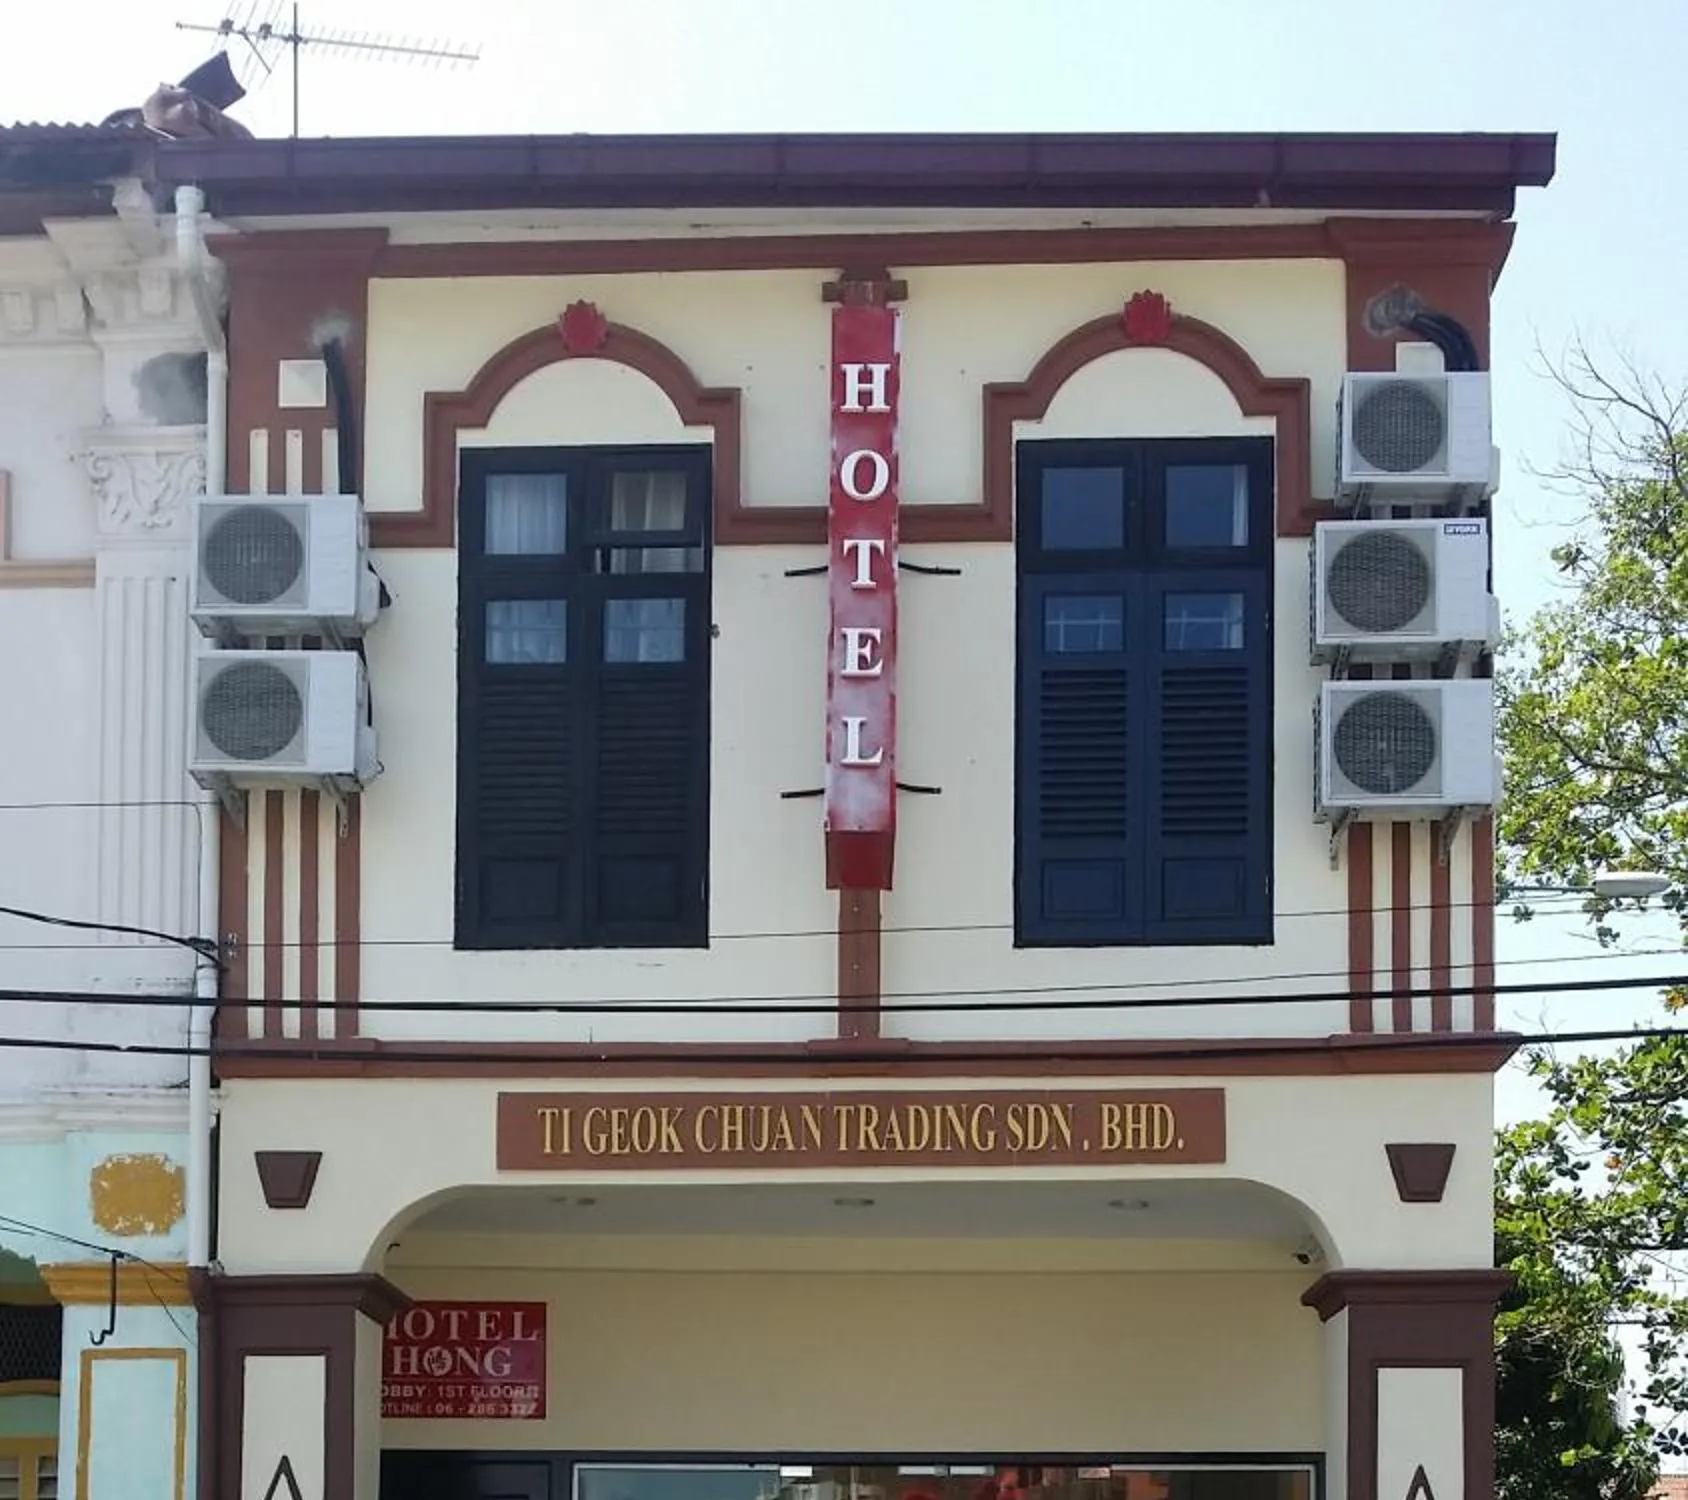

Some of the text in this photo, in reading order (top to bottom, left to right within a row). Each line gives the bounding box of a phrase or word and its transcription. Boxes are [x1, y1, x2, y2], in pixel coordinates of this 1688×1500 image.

[840, 363, 891, 766] HOTEL
[537, 1107, 571, 1153] TI
[583, 1107, 684, 1154] GEOK
[695, 1105, 823, 1152] CHUAN
[833, 1103, 996, 1152] TRADING
[1101, 1103, 1185, 1150] BHD.
[391, 1346, 512, 1377] HONG
[438, 1385, 468, 1398] 1ST
